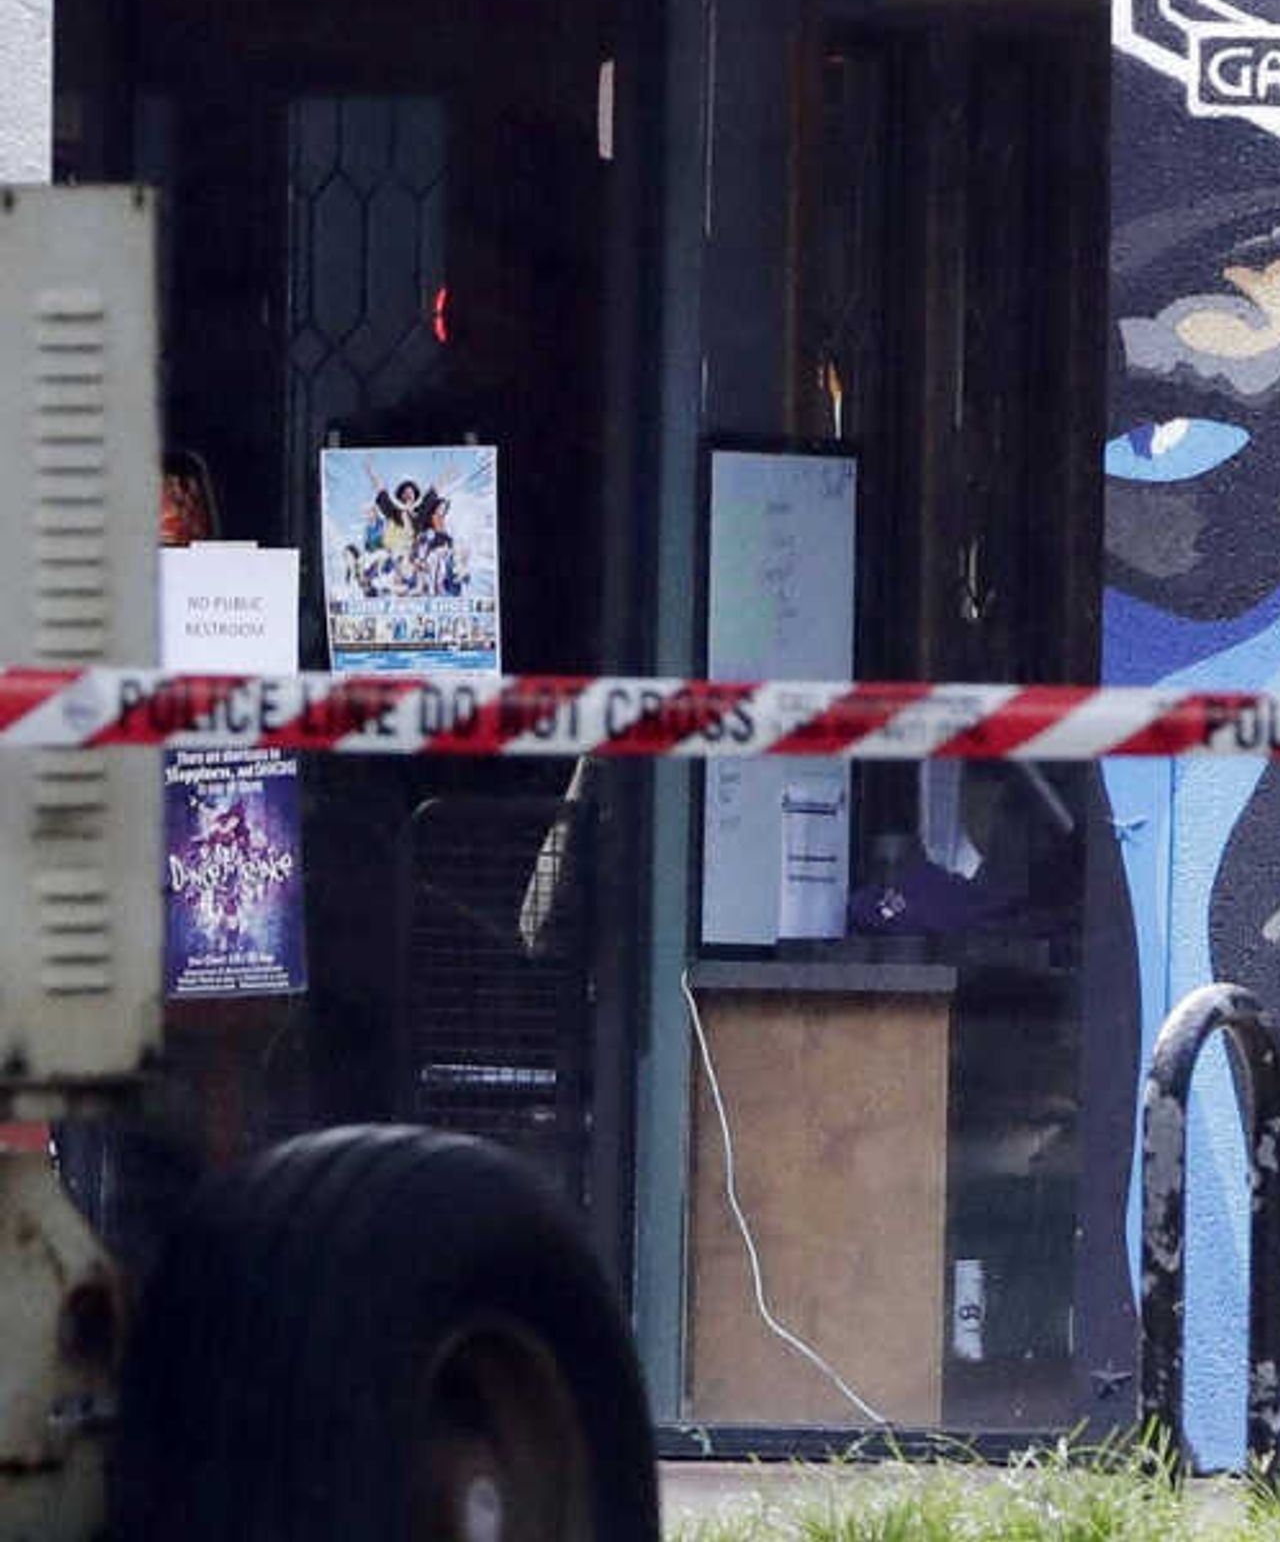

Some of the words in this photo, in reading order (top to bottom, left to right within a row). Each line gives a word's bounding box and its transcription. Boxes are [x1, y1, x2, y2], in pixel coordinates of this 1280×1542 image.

[187, 596, 210, 613] NO
[213, 596, 265, 613] PUBLIC
[185, 622, 266, 638] RESTROOM
[117, 679, 281, 733] POLICE
[301, 682, 396, 735] LINE
[418, 686, 477, 738] DO
[500, 686, 583, 739] NOT
[604, 687, 756, 743] CROSS
